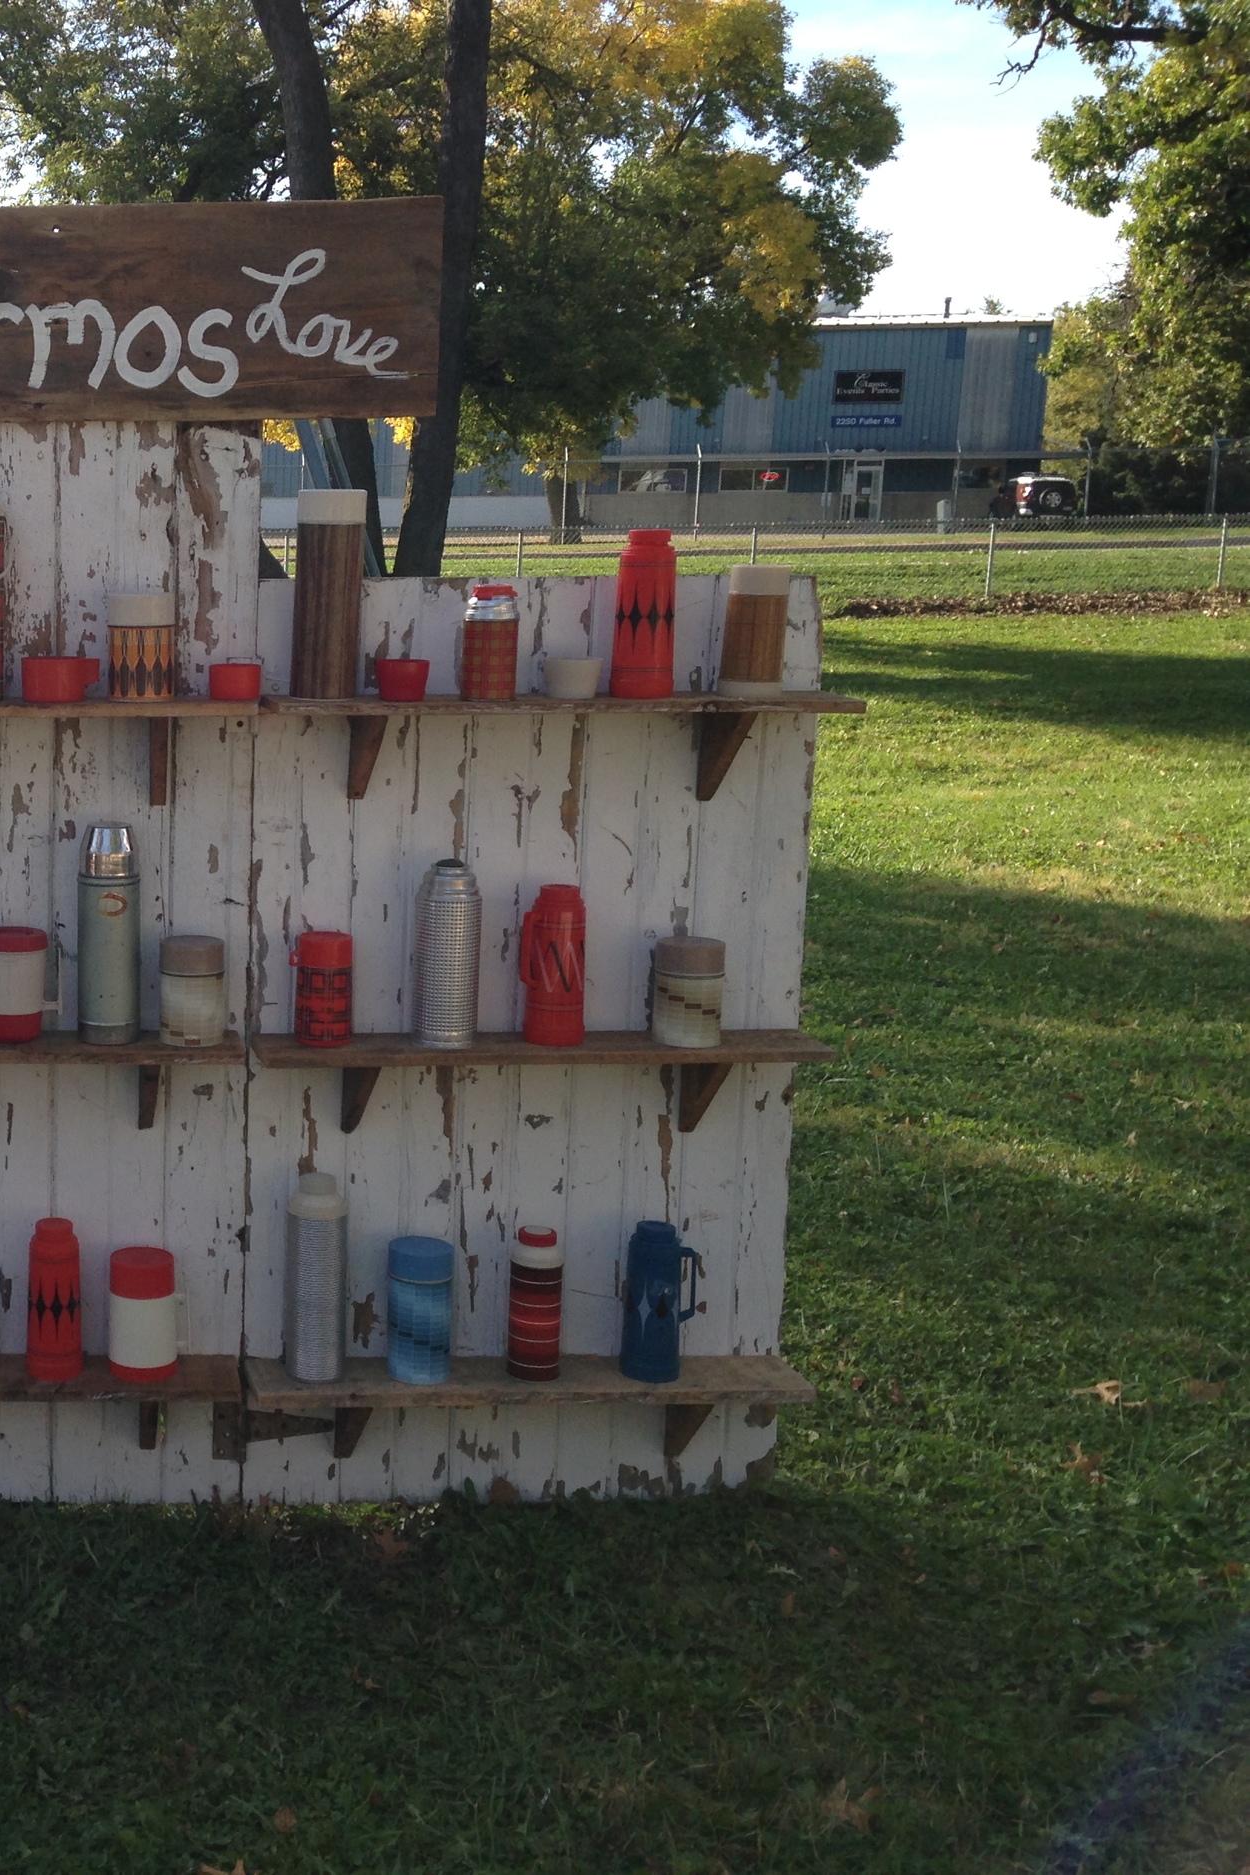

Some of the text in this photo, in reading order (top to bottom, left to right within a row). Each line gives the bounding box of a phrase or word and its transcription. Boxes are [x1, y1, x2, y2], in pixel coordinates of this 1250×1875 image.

[241, 248, 410, 379] Love
[836, 386, 900, 395] Events Parties
[835, 417, 897, 425] 2250 Fuller Rd.
